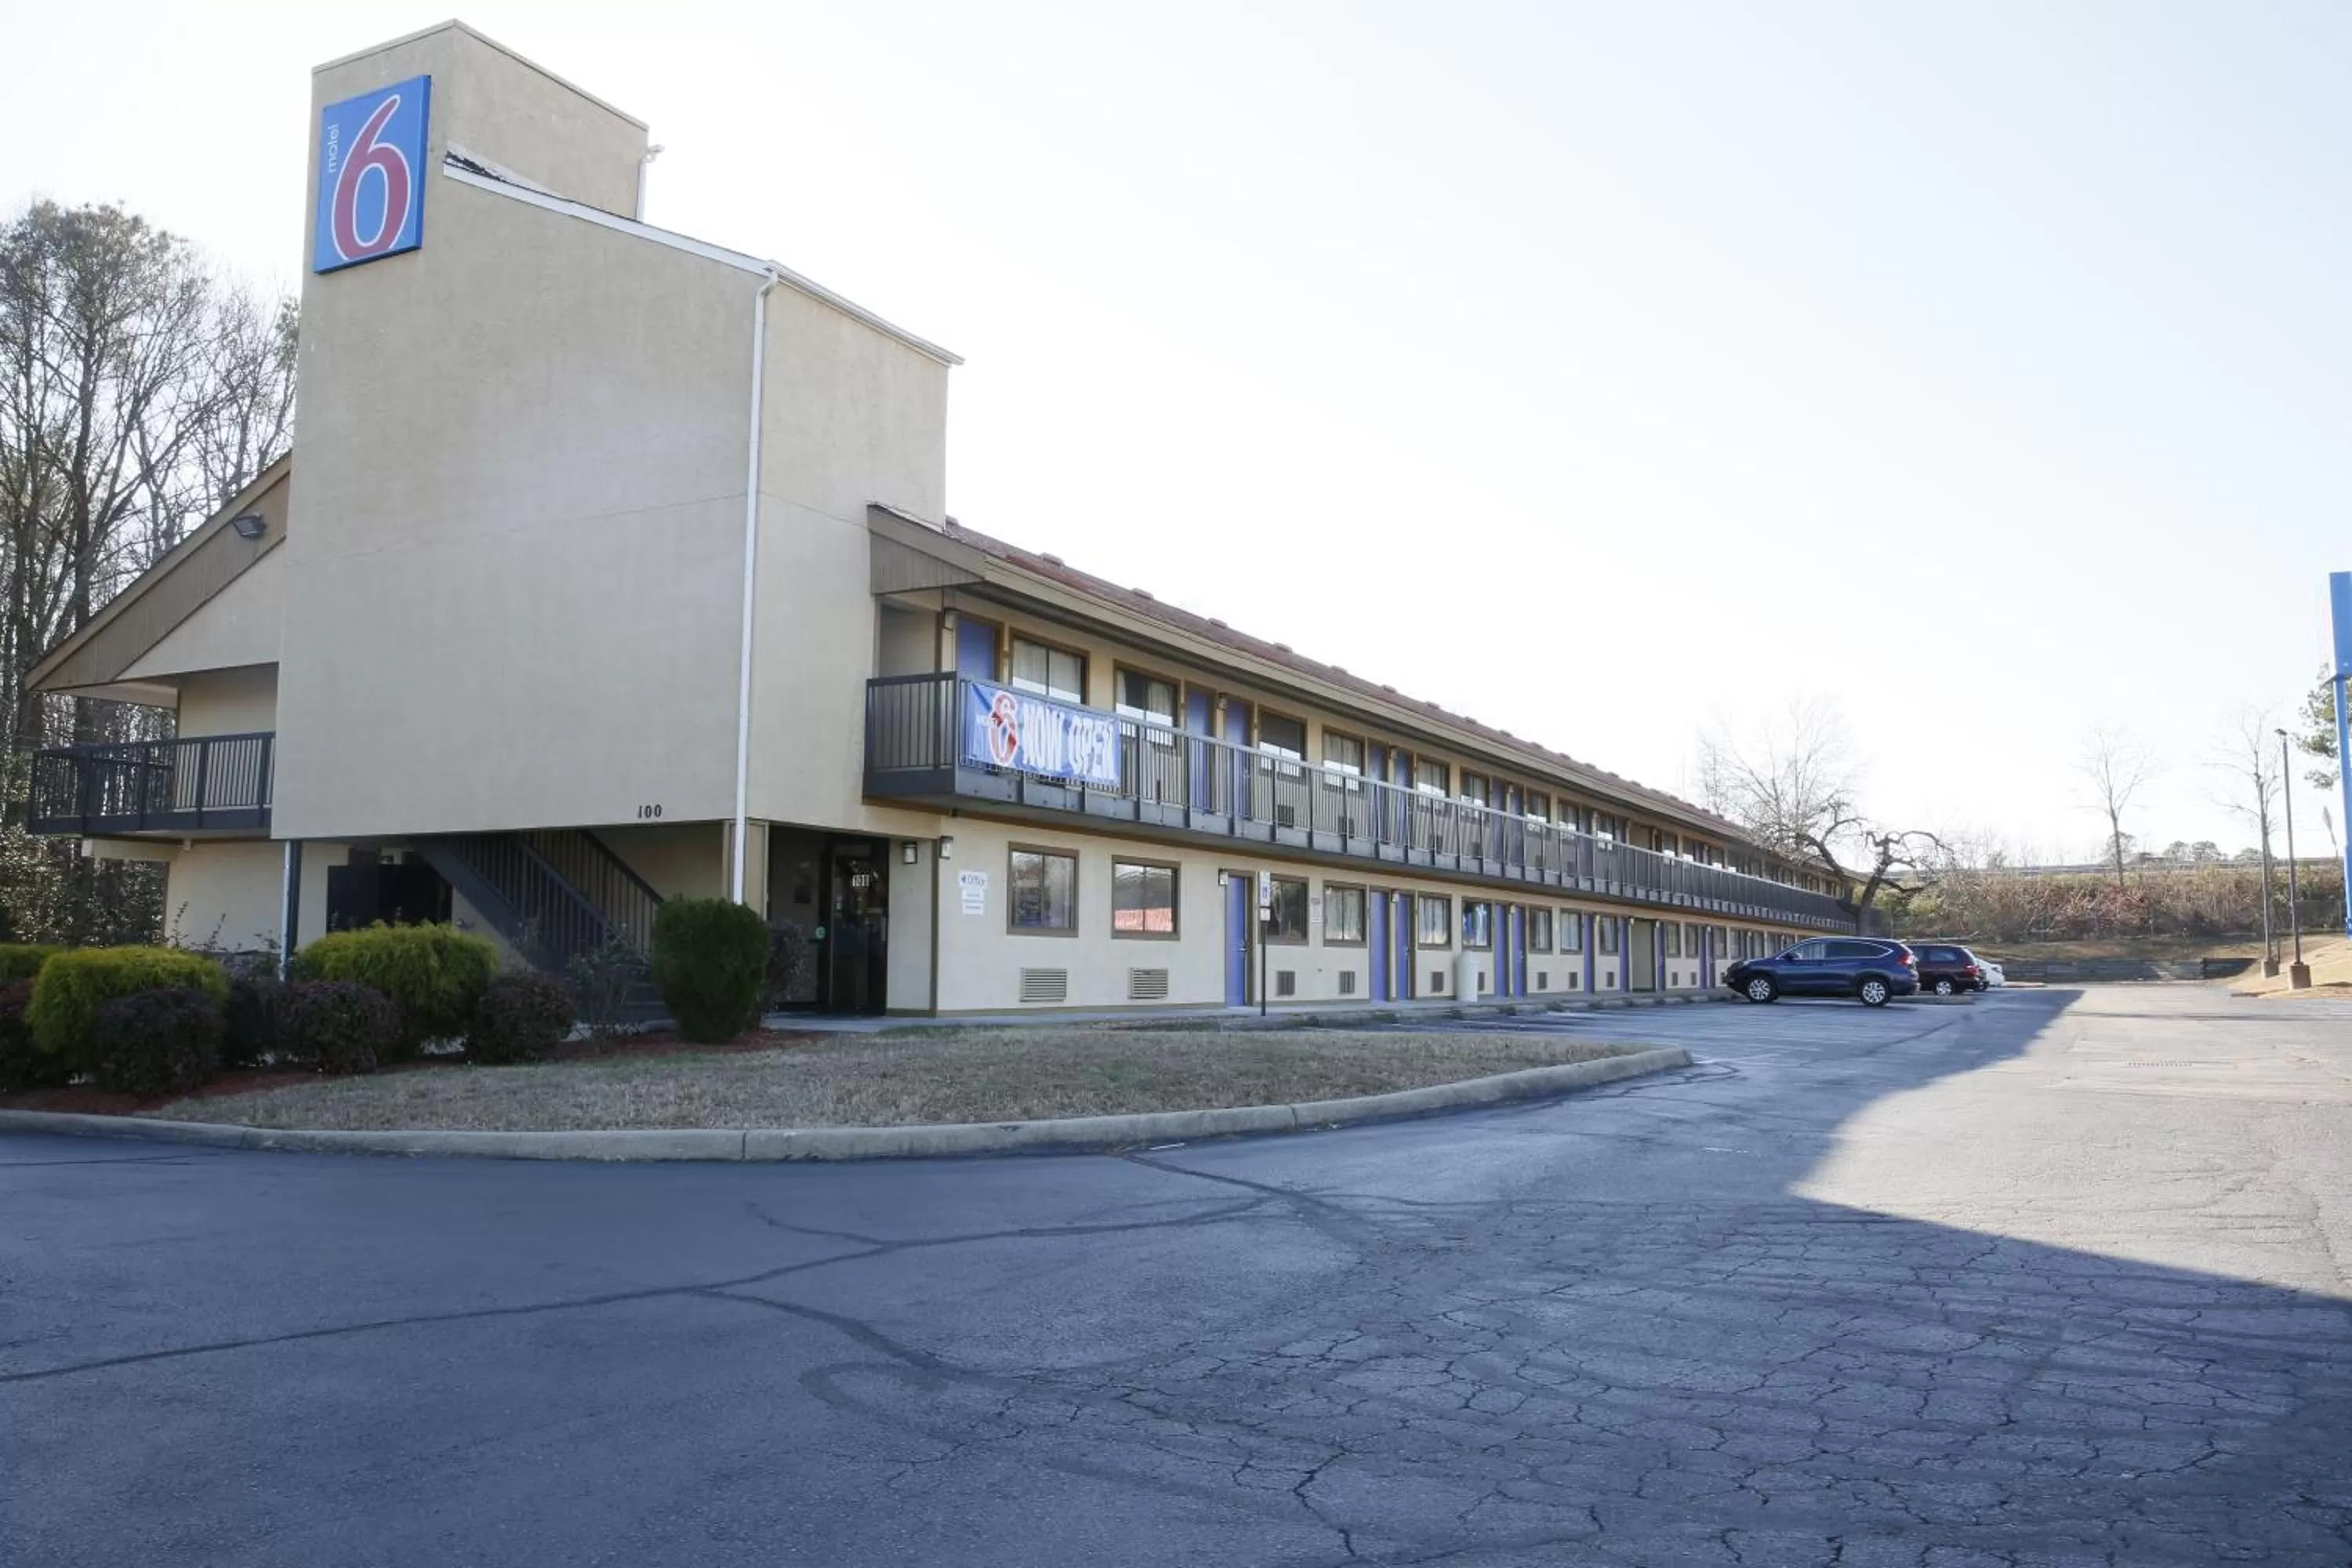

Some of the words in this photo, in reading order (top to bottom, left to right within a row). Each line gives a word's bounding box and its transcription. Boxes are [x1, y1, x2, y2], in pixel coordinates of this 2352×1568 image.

[328, 123, 339, 172] motel
[331, 93, 412, 261] 6
[1022, 701, 1065, 772] NOW
[1068, 713, 1116, 780] OPEN
[638, 804, 662, 819] 100
